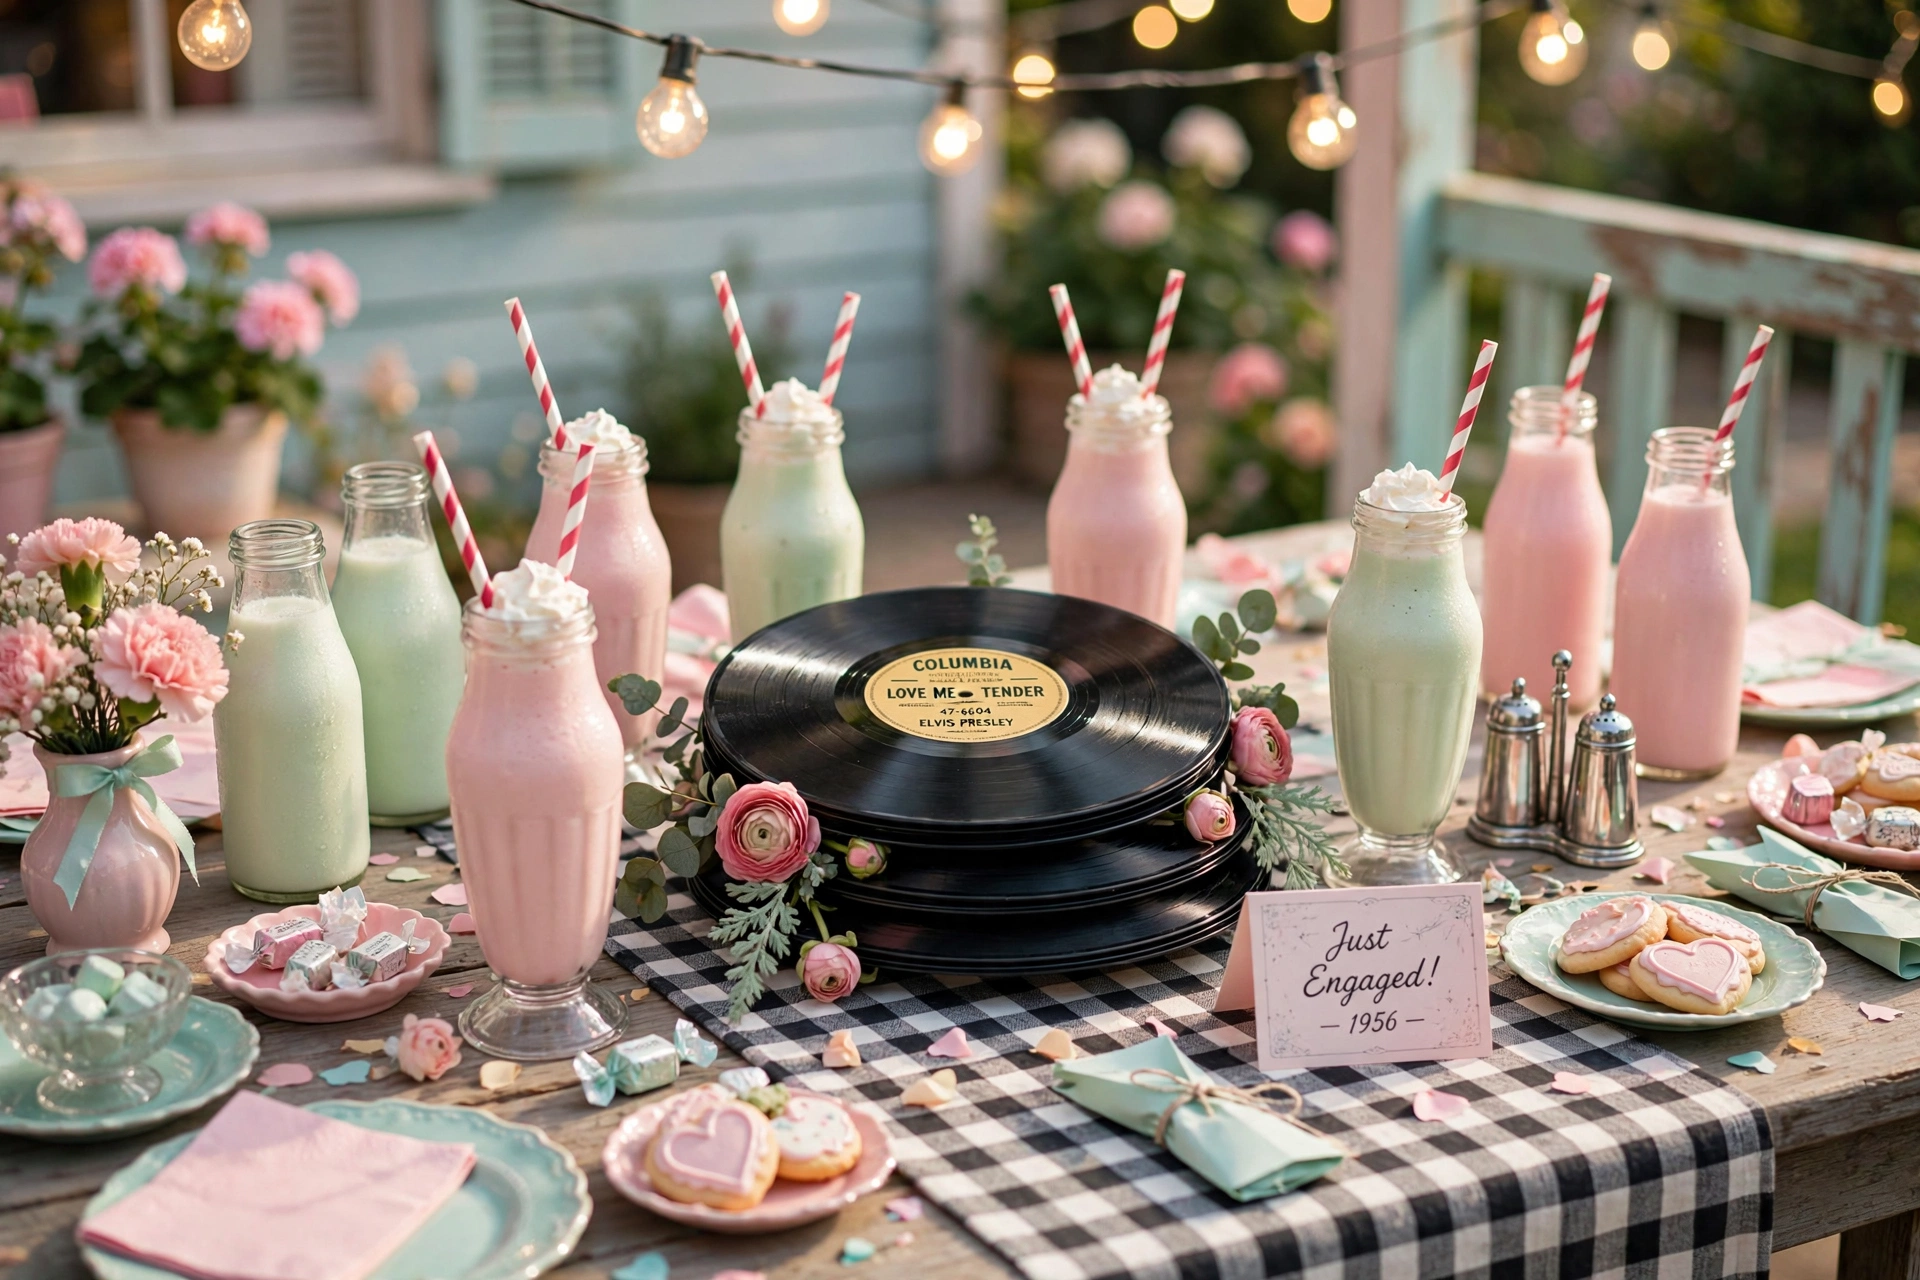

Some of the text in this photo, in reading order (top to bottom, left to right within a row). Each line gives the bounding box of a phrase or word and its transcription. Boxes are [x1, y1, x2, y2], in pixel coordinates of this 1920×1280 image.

[913, 657, 1013, 672] COLUMBIA
[887, 686, 1045, 699] LOVE ME TENDER
[940, 707, 992, 716] 47-6604
[919, 718, 1014, 728] ELVIS PRESLEY
[1325, 920, 1393, 962] Just
[1303, 955, 1441, 1007] Engaged!
[1349, 1010, 1398, 1034] 1956
